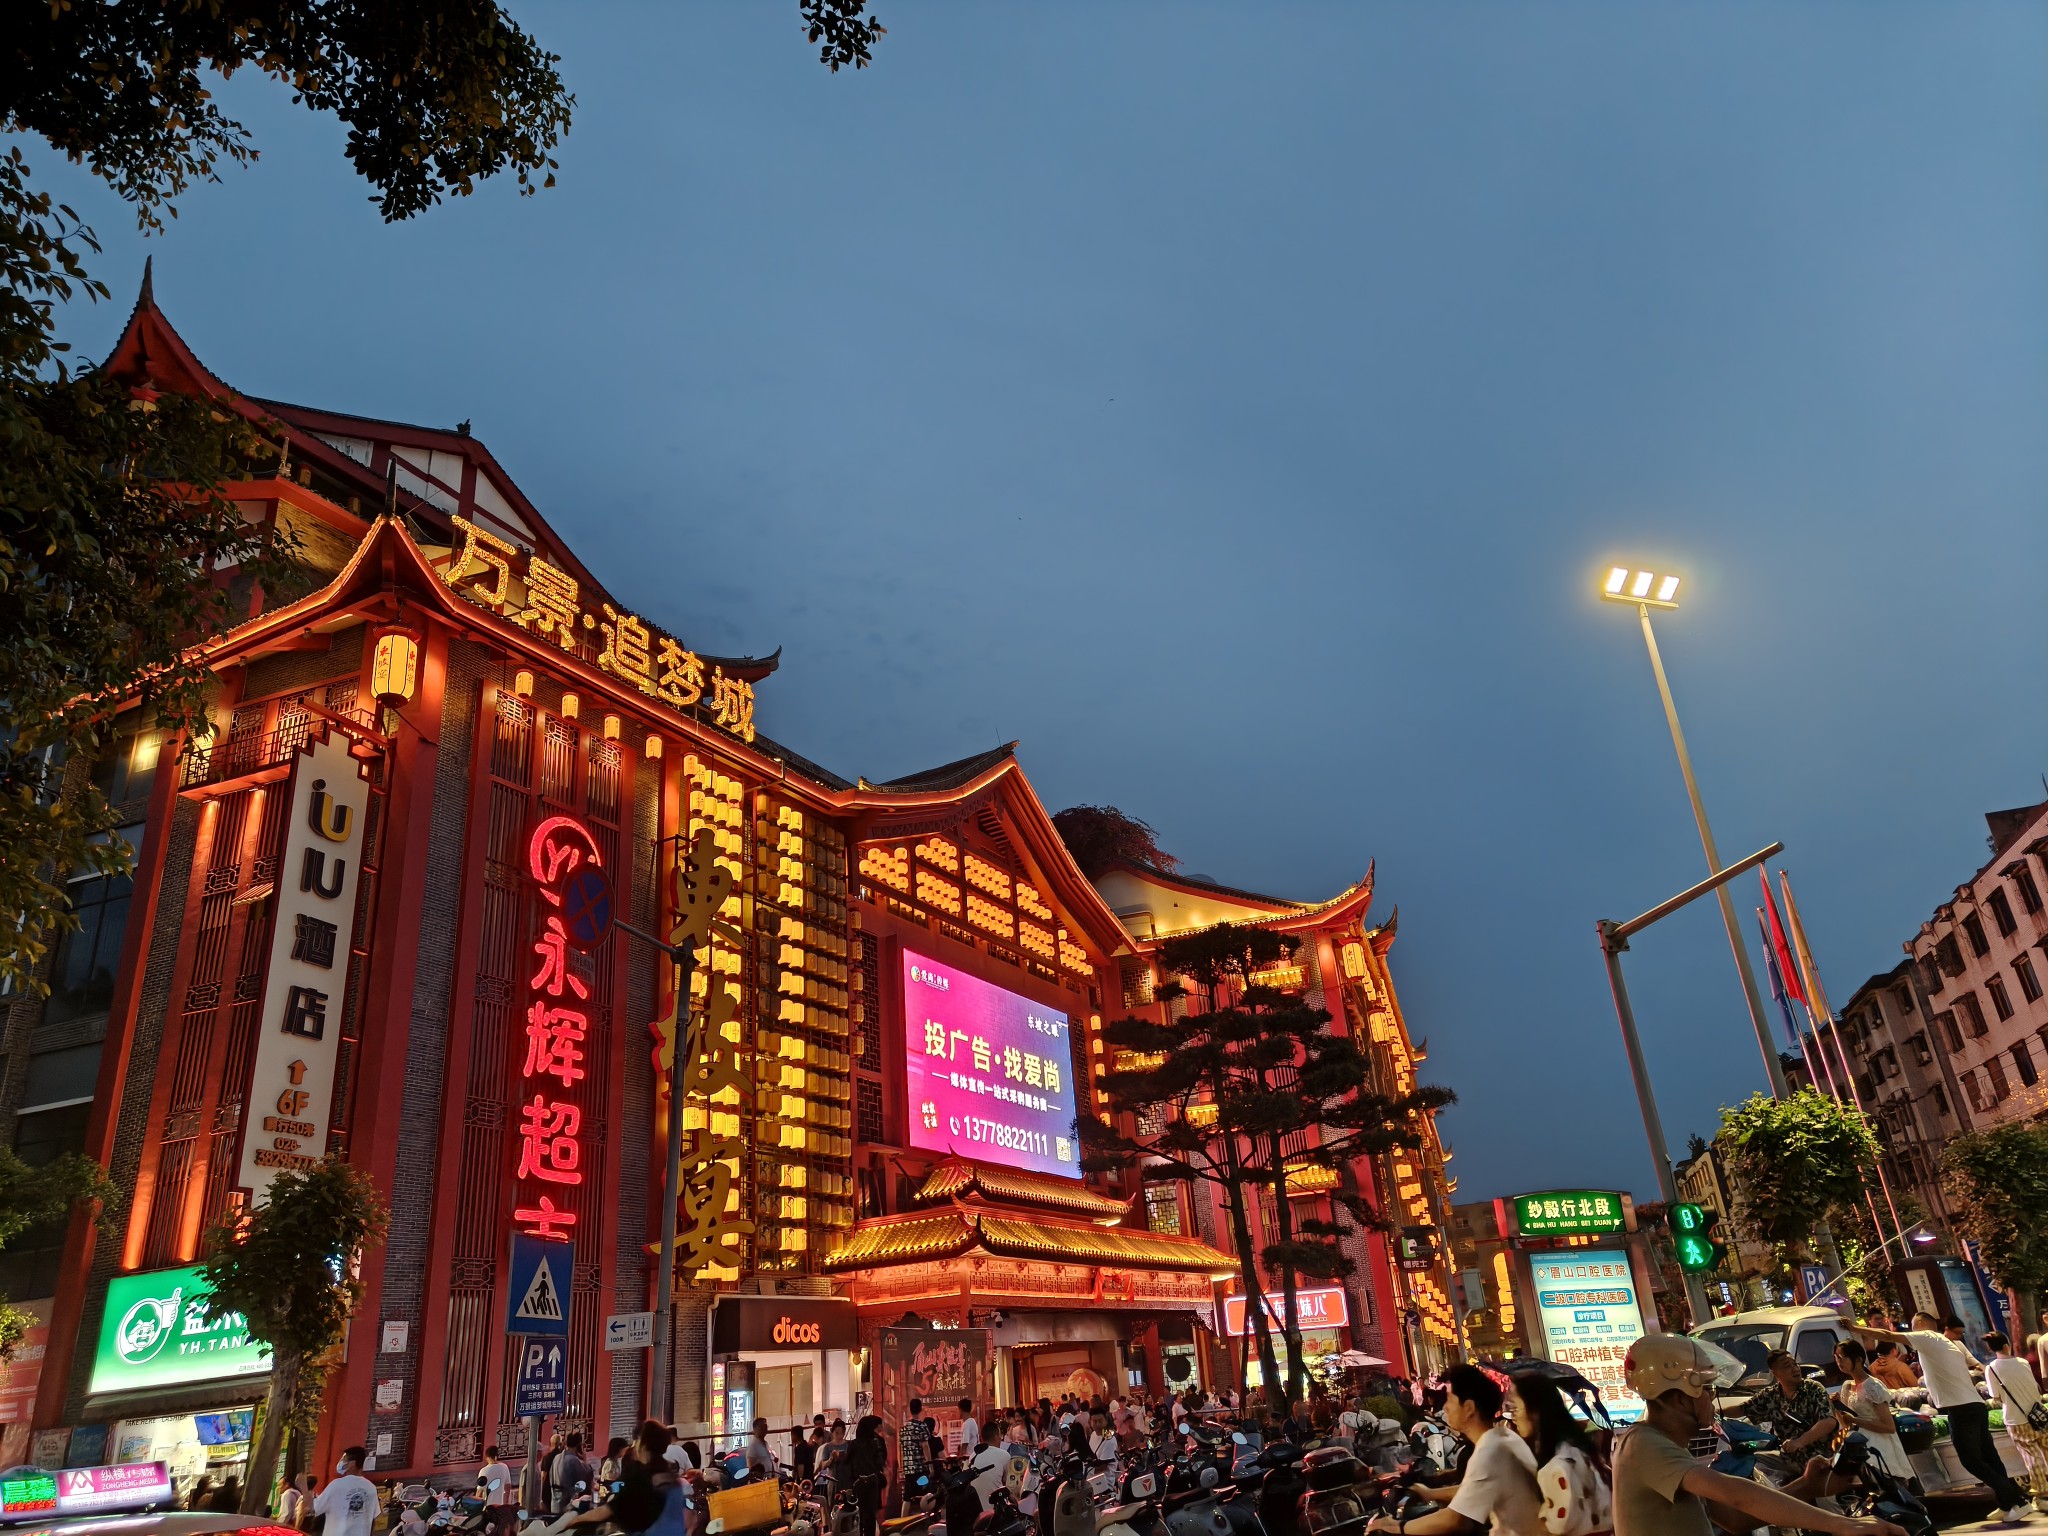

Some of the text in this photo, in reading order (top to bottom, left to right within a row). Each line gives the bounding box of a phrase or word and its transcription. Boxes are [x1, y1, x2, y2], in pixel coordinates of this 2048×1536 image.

[445, 514, 755, 743] 万景·追梦城
[923, 1018, 1061, 1094] 投广告·找爱尚
[276, 1088, 310, 1117] 6F
[963, 1114, 1049, 1156] 13778822111
[1559, 1220, 1578, 1228] HANG
[1550, 1263, 1628, 1279] 眉山口腔医院
[1273, 1296, 1327, 1319] 东妹儿
[1544, 1290, 1629, 1305] 二级口腔专科医院
[773, 1316, 820, 1344] dicos
[526, 1344, 544, 1379] P
[1554, 1345, 1630, 1363] 口腔种植专
[102, 1477, 159, 1490] ZONGHENG MEDIA
